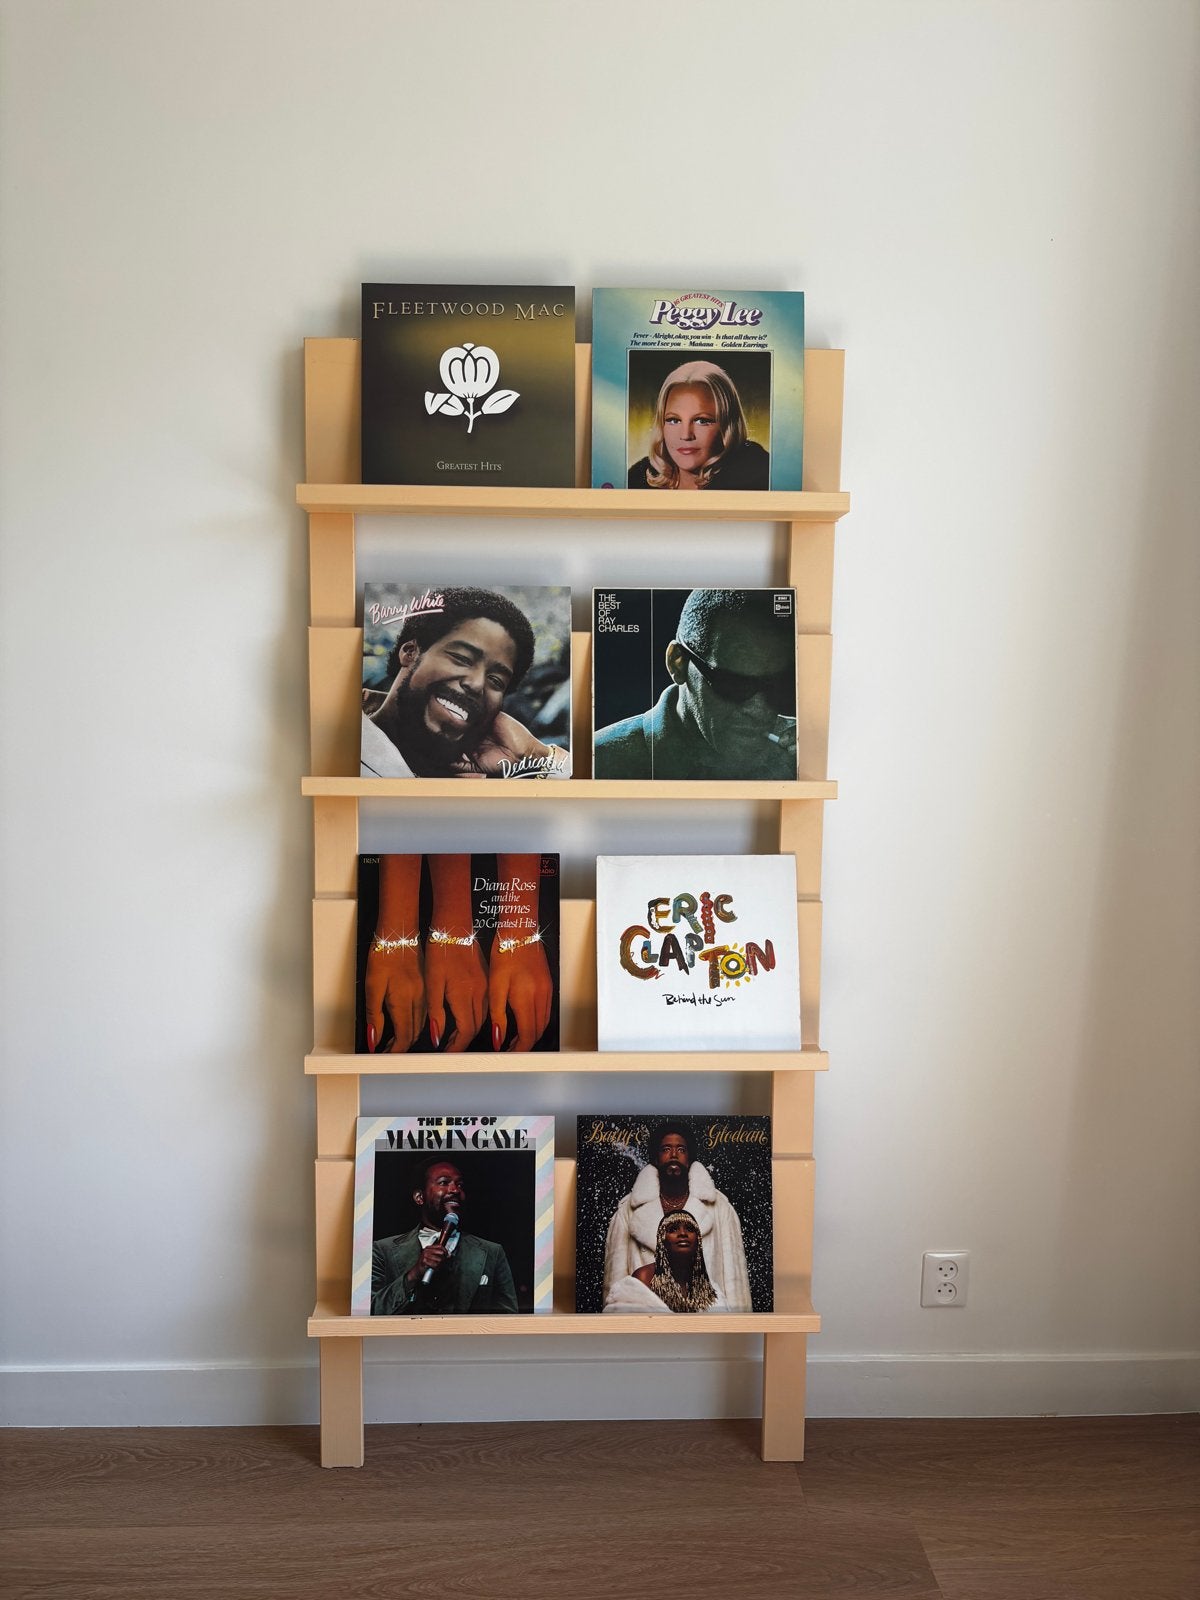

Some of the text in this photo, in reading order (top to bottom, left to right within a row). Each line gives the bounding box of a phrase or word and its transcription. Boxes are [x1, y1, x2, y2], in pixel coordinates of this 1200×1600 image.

[680, 293, 711, 302] GREATEST
[710, 297, 725, 308] HITS
[372, 302, 565, 321] FLEETWOOD MAC
[649, 300, 763, 330] Peggy Lee
[436, 461, 502, 471] GREATEST HITS
[598, 594, 617, 602] THE
[598, 601, 621, 610] BEST
[369, 589, 445, 625] Barry White
[598, 609, 611, 617] OF
[598, 617, 615, 625] RAY
[598, 624, 640, 633] CHARLES
[497, 755, 569, 778] Dedicated
[473, 877, 537, 891] Diana Ross
[491, 891, 521, 902] and the
[478, 900, 531, 917] Supremes
[473, 917, 537, 929] 20 Greatest Hits
[648, 891, 738, 944] ERIC
[620, 925, 776, 989] CLAPTON
[662, 992, 736, 1007] Behind the Sun
[417, 1117, 498, 1126] THE BEST OF
[384, 1129, 529, 1149] MARVIN GAYE
[582, 1120, 633, 1146] Barry
[703, 1123, 769, 1148] Glodean
